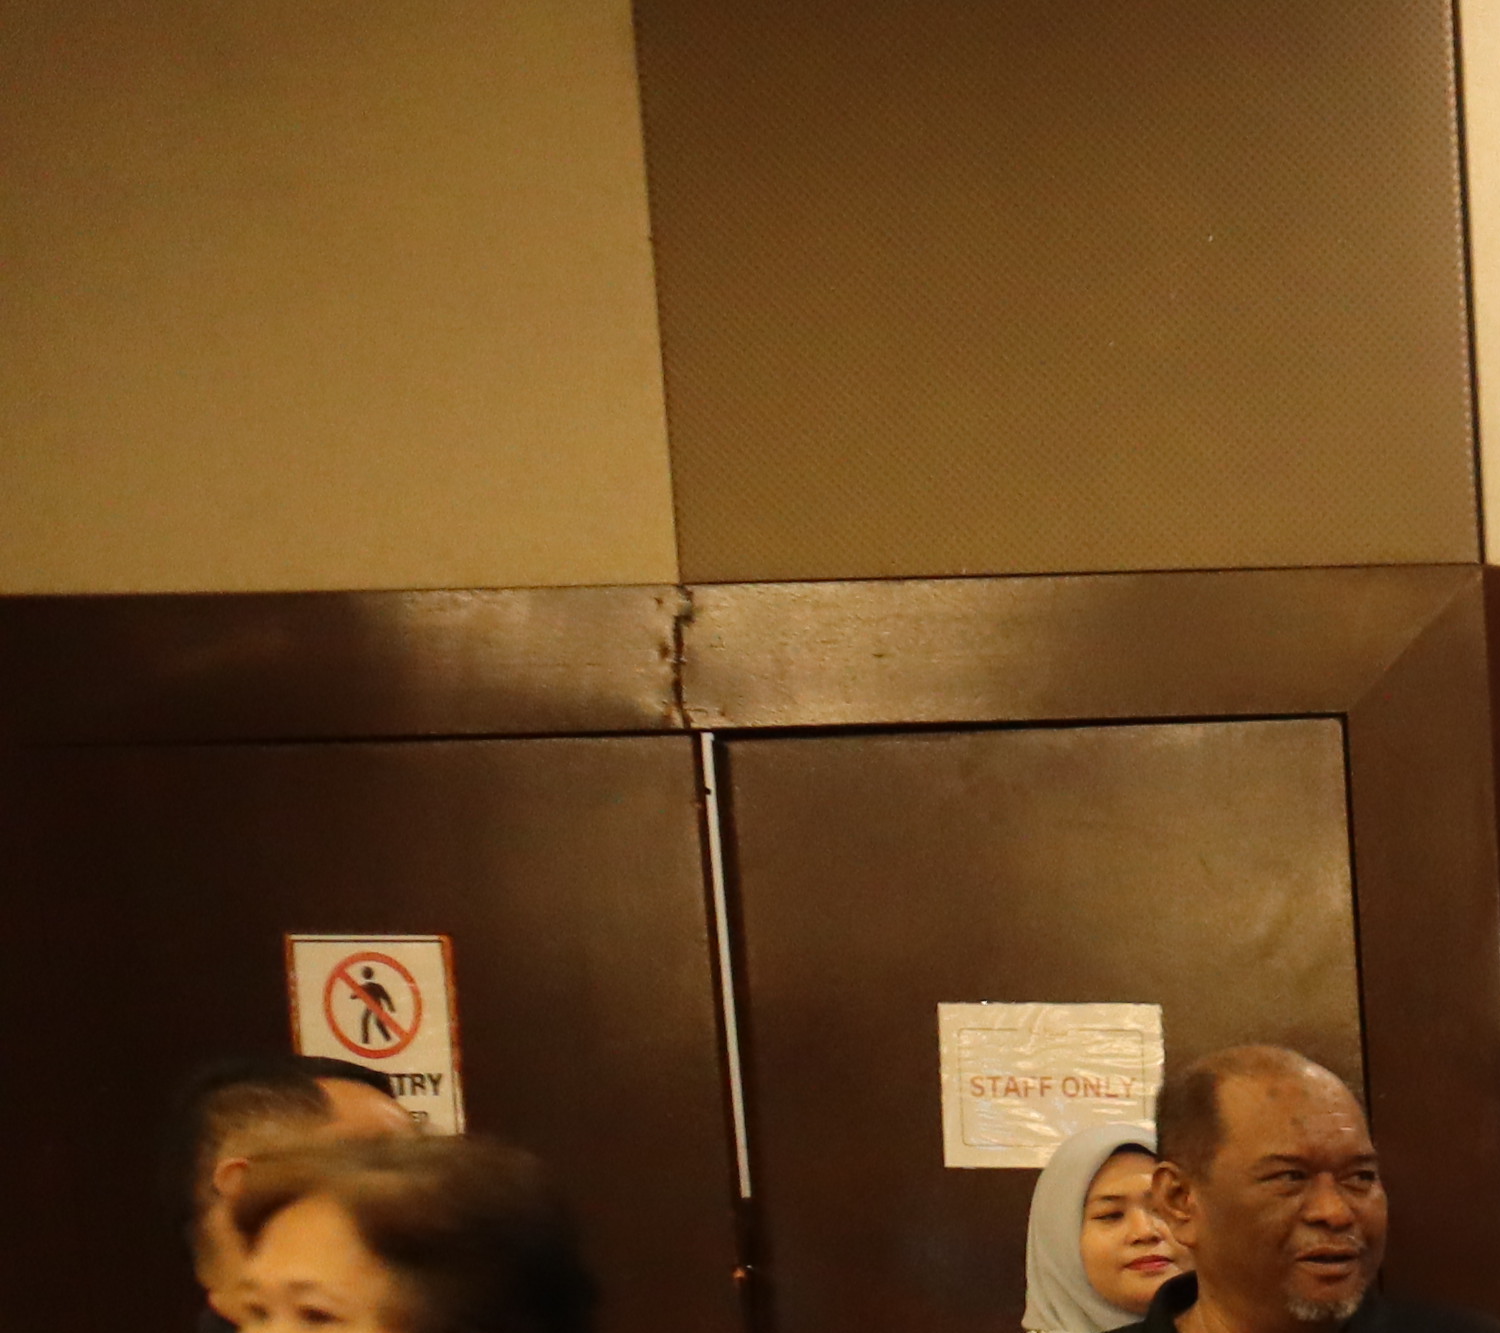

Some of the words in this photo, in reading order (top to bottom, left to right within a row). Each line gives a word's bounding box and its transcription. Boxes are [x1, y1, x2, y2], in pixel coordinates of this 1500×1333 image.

[388, 1072, 443, 1097] TRY
[969, 1075, 1053, 1098] STAFF
[1061, 1075, 1137, 1098] ONLY
